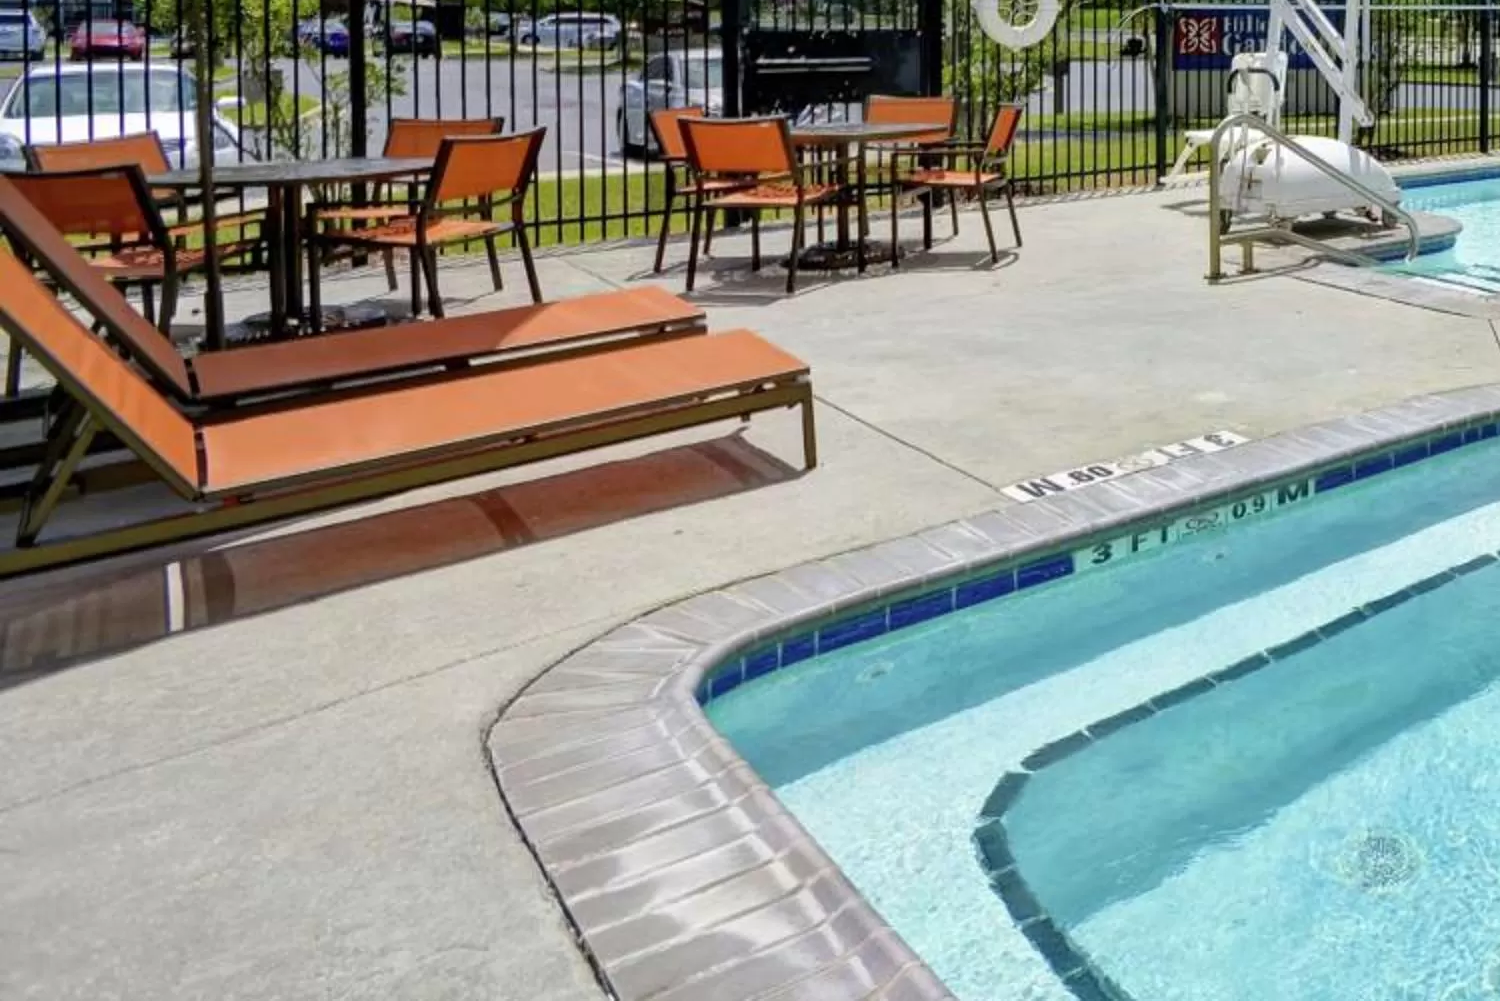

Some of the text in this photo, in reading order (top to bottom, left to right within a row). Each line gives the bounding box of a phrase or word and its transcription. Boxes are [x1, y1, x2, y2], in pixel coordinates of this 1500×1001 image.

[1016, 477, 1065, 497] M
[1092, 543, 1113, 564] 3
[1277, 478, 1309, 504] M
